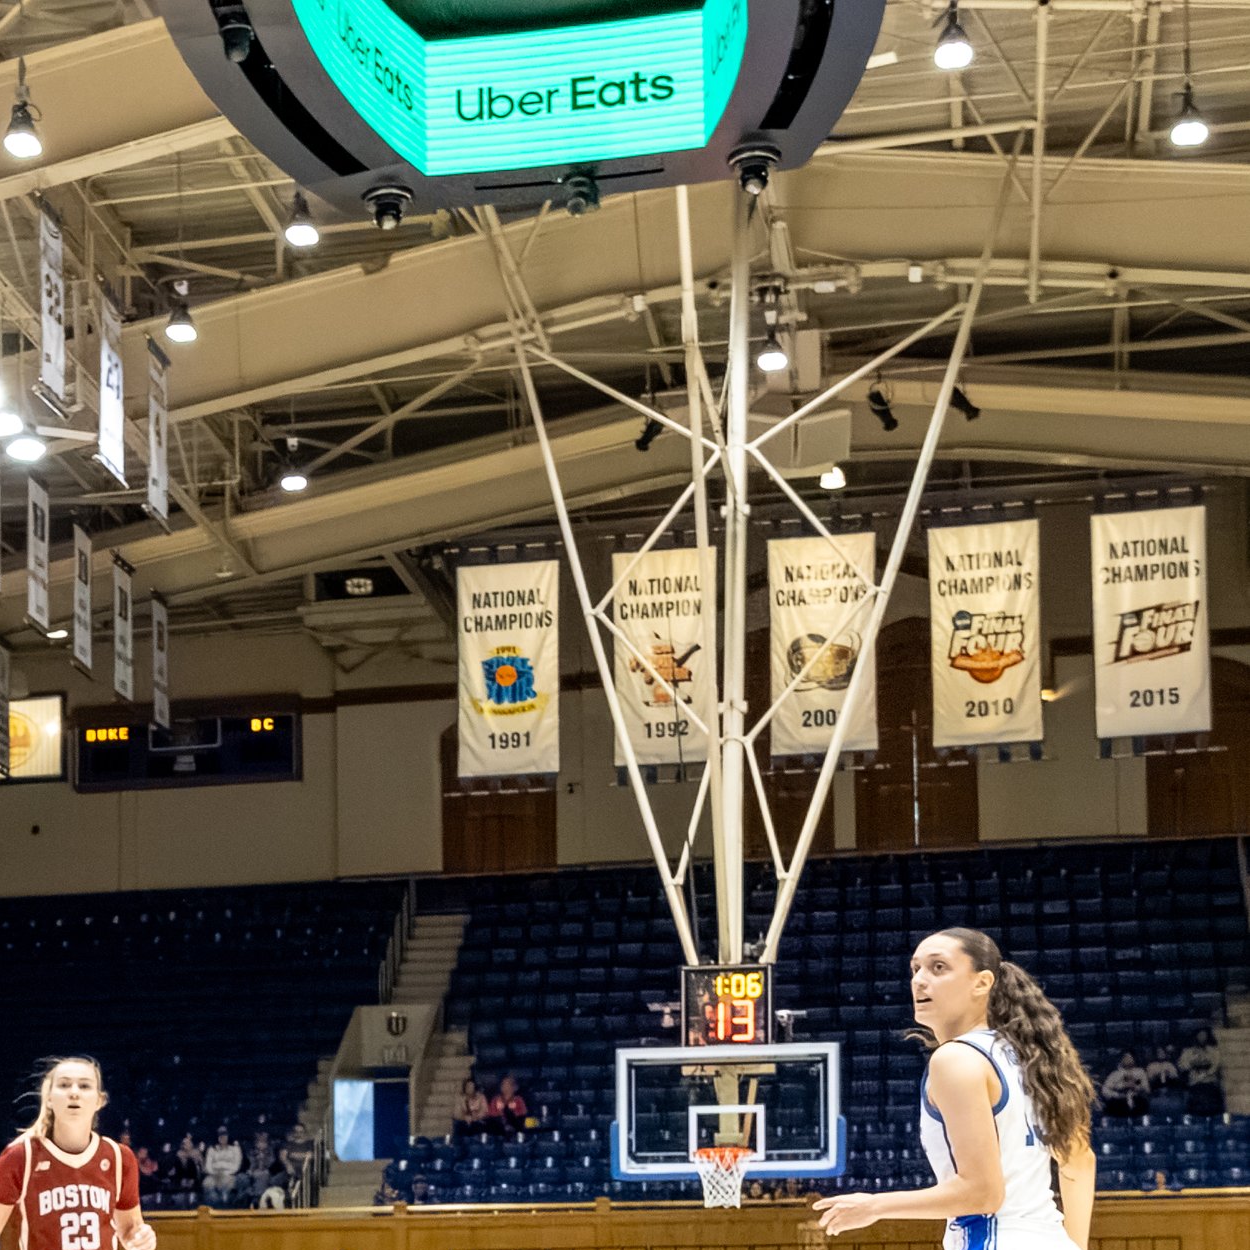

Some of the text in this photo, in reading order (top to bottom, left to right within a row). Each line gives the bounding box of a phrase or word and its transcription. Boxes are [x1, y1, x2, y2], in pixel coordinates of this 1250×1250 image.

[374, 47, 413, 111] Eats
[455, 72, 675, 121] Uber Eats
[1109, 536, 1189, 560] NATIONAL
[946, 550, 1024, 572] NATIONAL
[1102, 559, 1200, 584] CHAMPIONS
[629, 575, 702, 597] NATIONAL
[937, 572, 1033, 596] CHAMPIONS
[472, 588, 544, 609] NATIONAL
[464, 610, 553, 633] CHAMPIONS
[971, 614, 1024, 635] FINAL
[1142, 603, 1195, 629] FINAL
[951, 633, 1025, 659] FOUR
[1119, 620, 1194, 658] FOUR
[965, 697, 1014, 718] 2010
[1129, 687, 1180, 708] 2015
[250, 717, 275, 732] BC
[644, 720, 689, 739] 1992
[802, 708, 838, 728] 200
[85, 727, 129, 742] DUKE
[488, 731, 531, 750] 1991
[716, 973, 763, 999] 1:06
[717, 1000, 755, 1042] 13
[39, 1184, 110, 1215] BOSTON
[60, 1212, 100, 1250] 23
